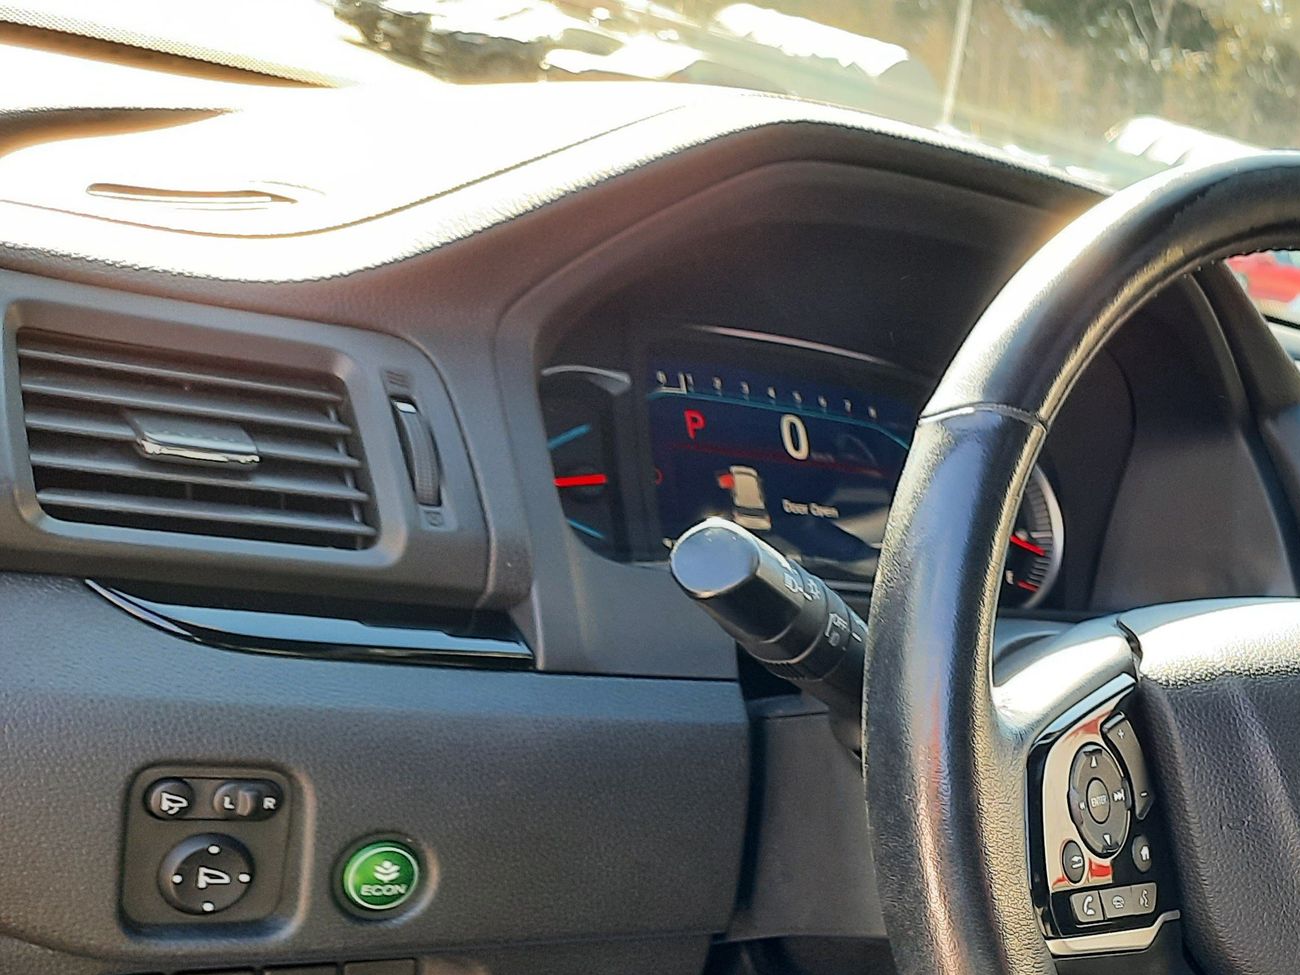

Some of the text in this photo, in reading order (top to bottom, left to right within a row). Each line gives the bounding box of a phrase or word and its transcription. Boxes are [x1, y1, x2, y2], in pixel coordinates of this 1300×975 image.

[684, 408, 706, 440] P
[780, 414, 810, 461] 0
[223, 796, 276, 810] L R
[360, 884, 407, 897] ECON
